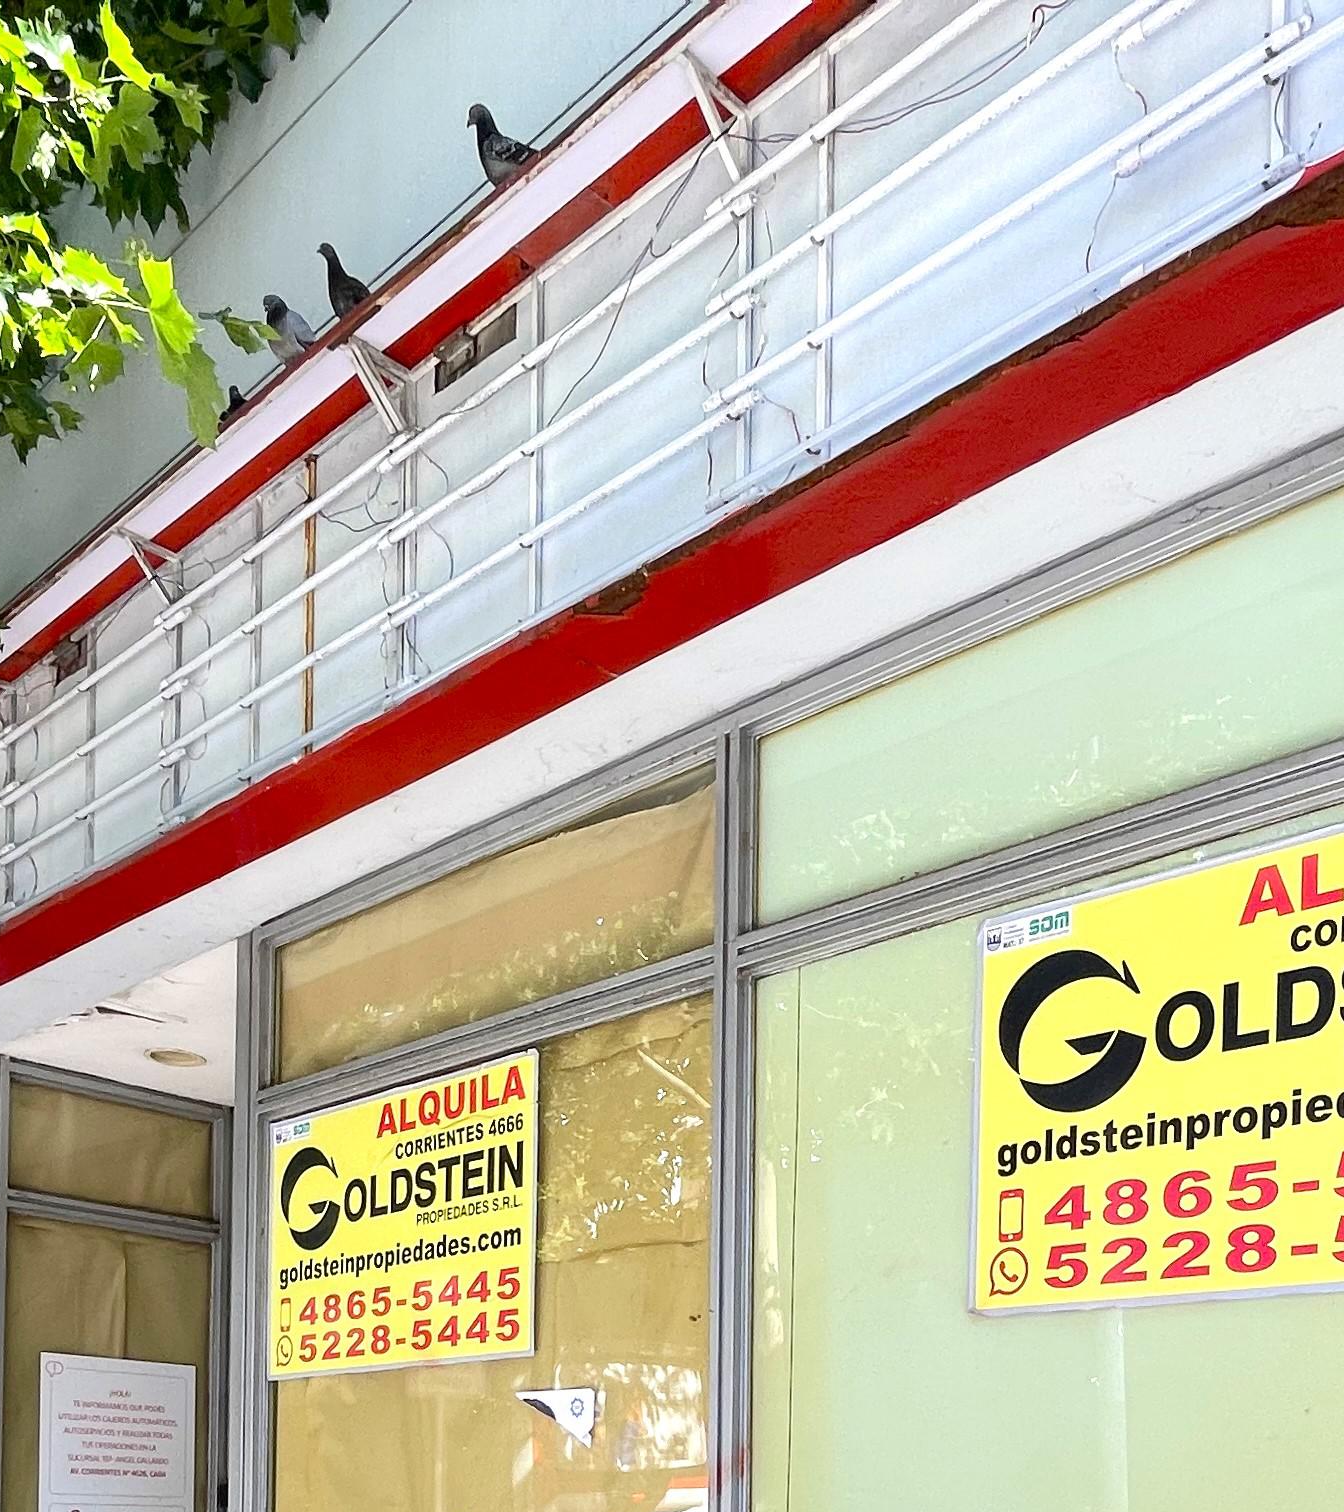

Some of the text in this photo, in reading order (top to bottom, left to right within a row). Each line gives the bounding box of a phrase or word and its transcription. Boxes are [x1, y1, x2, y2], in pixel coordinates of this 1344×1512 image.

[376, 1065, 526, 1138] ALQUILA
[395, 1113, 524, 1159] CORRIENTES 4666
[281, 1141, 524, 1251] GOLDSTEIN
[416, 1195, 523, 1226] PROPIEDADES S.R.L.
[279, 1227, 522, 1290] goldsteinpropiedades.com
[299, 1266, 521, 1326] 4865-5445
[299, 1308, 520, 1362] 5228-5445
